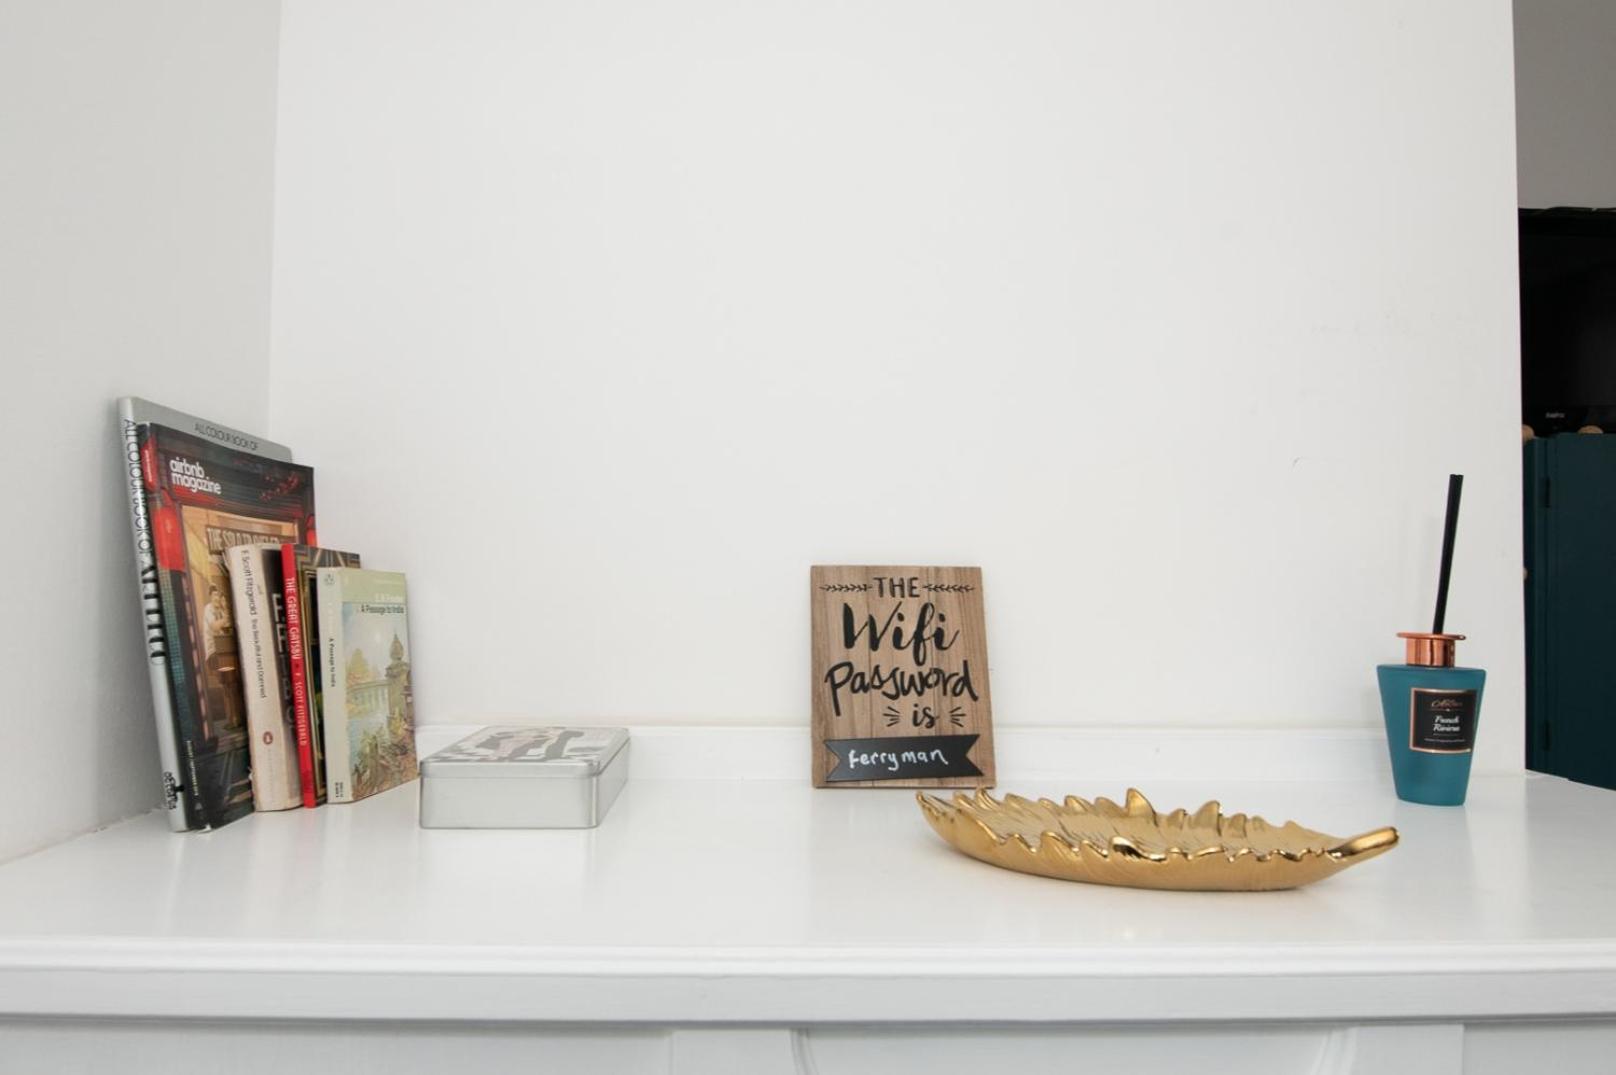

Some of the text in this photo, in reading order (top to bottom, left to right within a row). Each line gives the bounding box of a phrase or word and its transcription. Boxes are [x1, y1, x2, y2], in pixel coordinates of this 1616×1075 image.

[124, 419, 138, 440] ALL
[127, 442, 148, 496] COLOUR
[169, 456, 205, 478] airbnb
[171, 472, 222, 495] magazine
[138, 541, 155, 557] OF
[285, 577, 294, 591] THE
[874, 577, 921, 598] THE
[287, 596, 297, 623] GREAT
[289, 627, 300, 659] GATSBY
[843, 601, 960, 666] Wifi
[824, 659, 979, 717] Password
[911, 703, 940, 729] is
